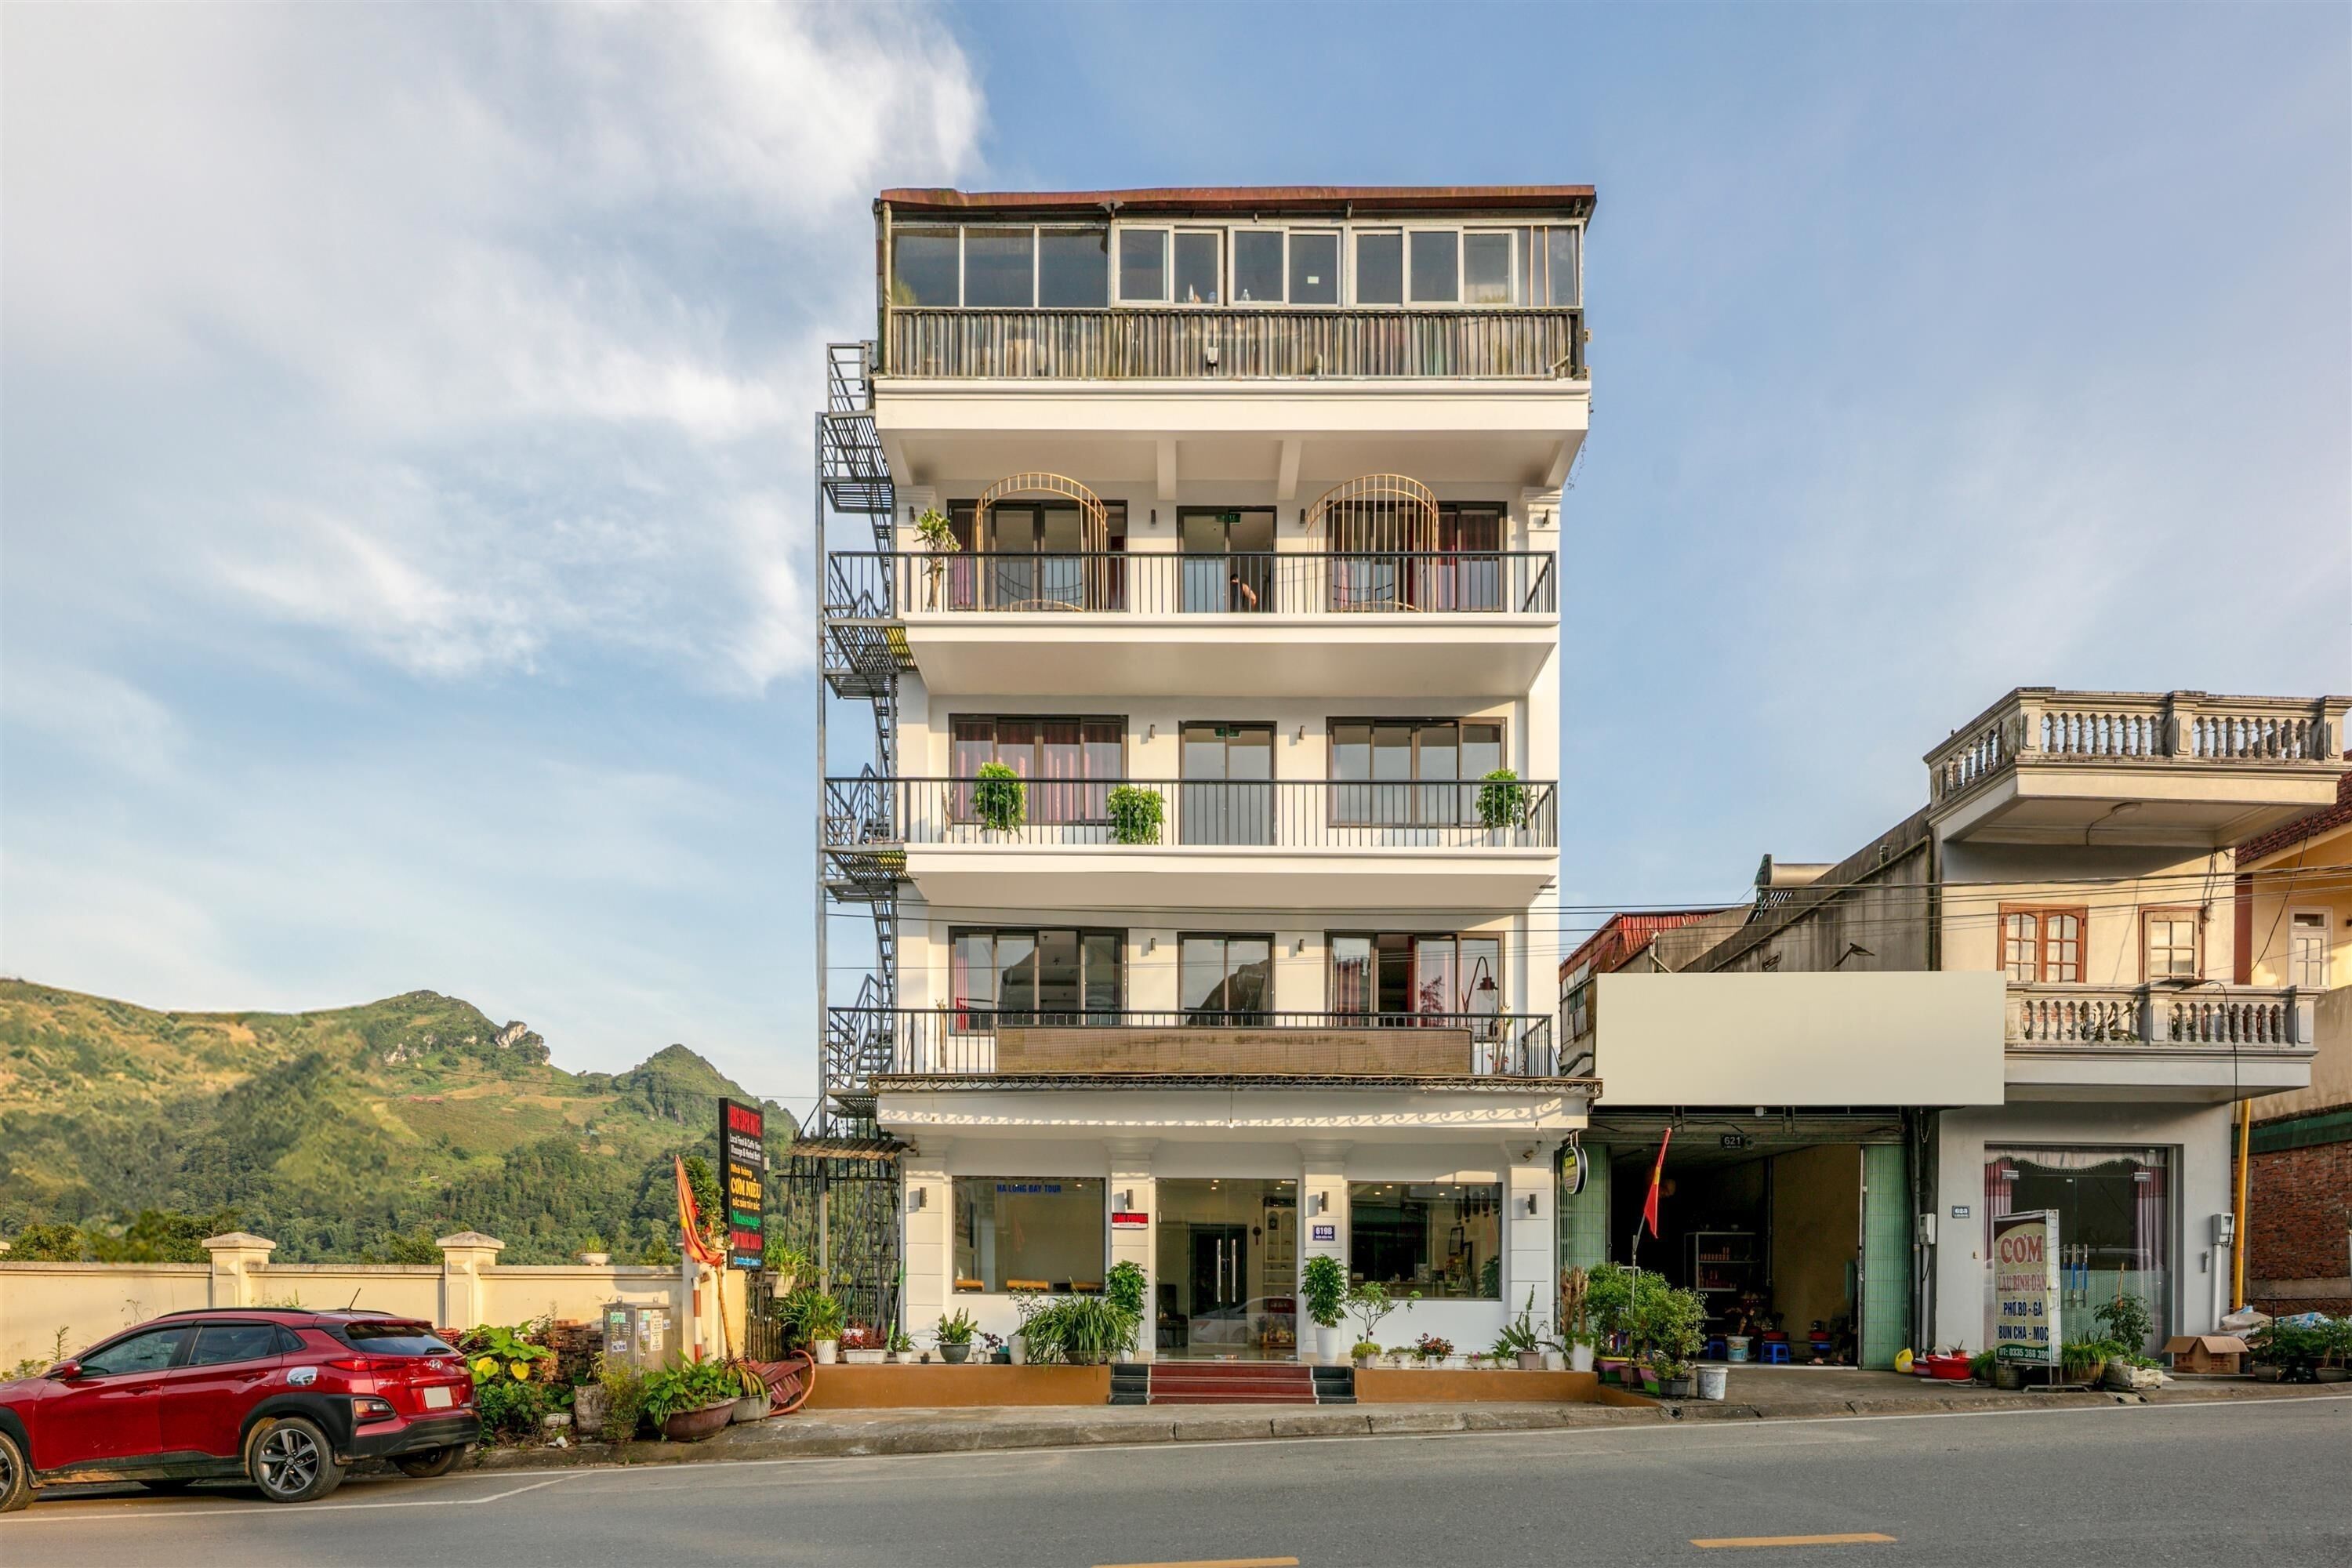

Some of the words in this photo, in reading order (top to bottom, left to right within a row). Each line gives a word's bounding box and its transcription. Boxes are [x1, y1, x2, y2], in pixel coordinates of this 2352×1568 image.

[1565, 1156, 1576, 1167] GLOW
[1008, 1184, 1027, 1192] LONG
[732, 1210, 761, 1230] Massage
[2000, 1233, 2043, 1264] CƠM
[2003, 1296, 2016, 1316] PHỞ
[2018, 1298, 2027, 1316] BÒ
[2033, 1298, 2043, 1316] GÀ
[1998, 1323, 2012, 1339] BÚN
[2013, 1319, 2027, 1340] CHẢ
[2033, 1326, 2049, 1344] MỌC
